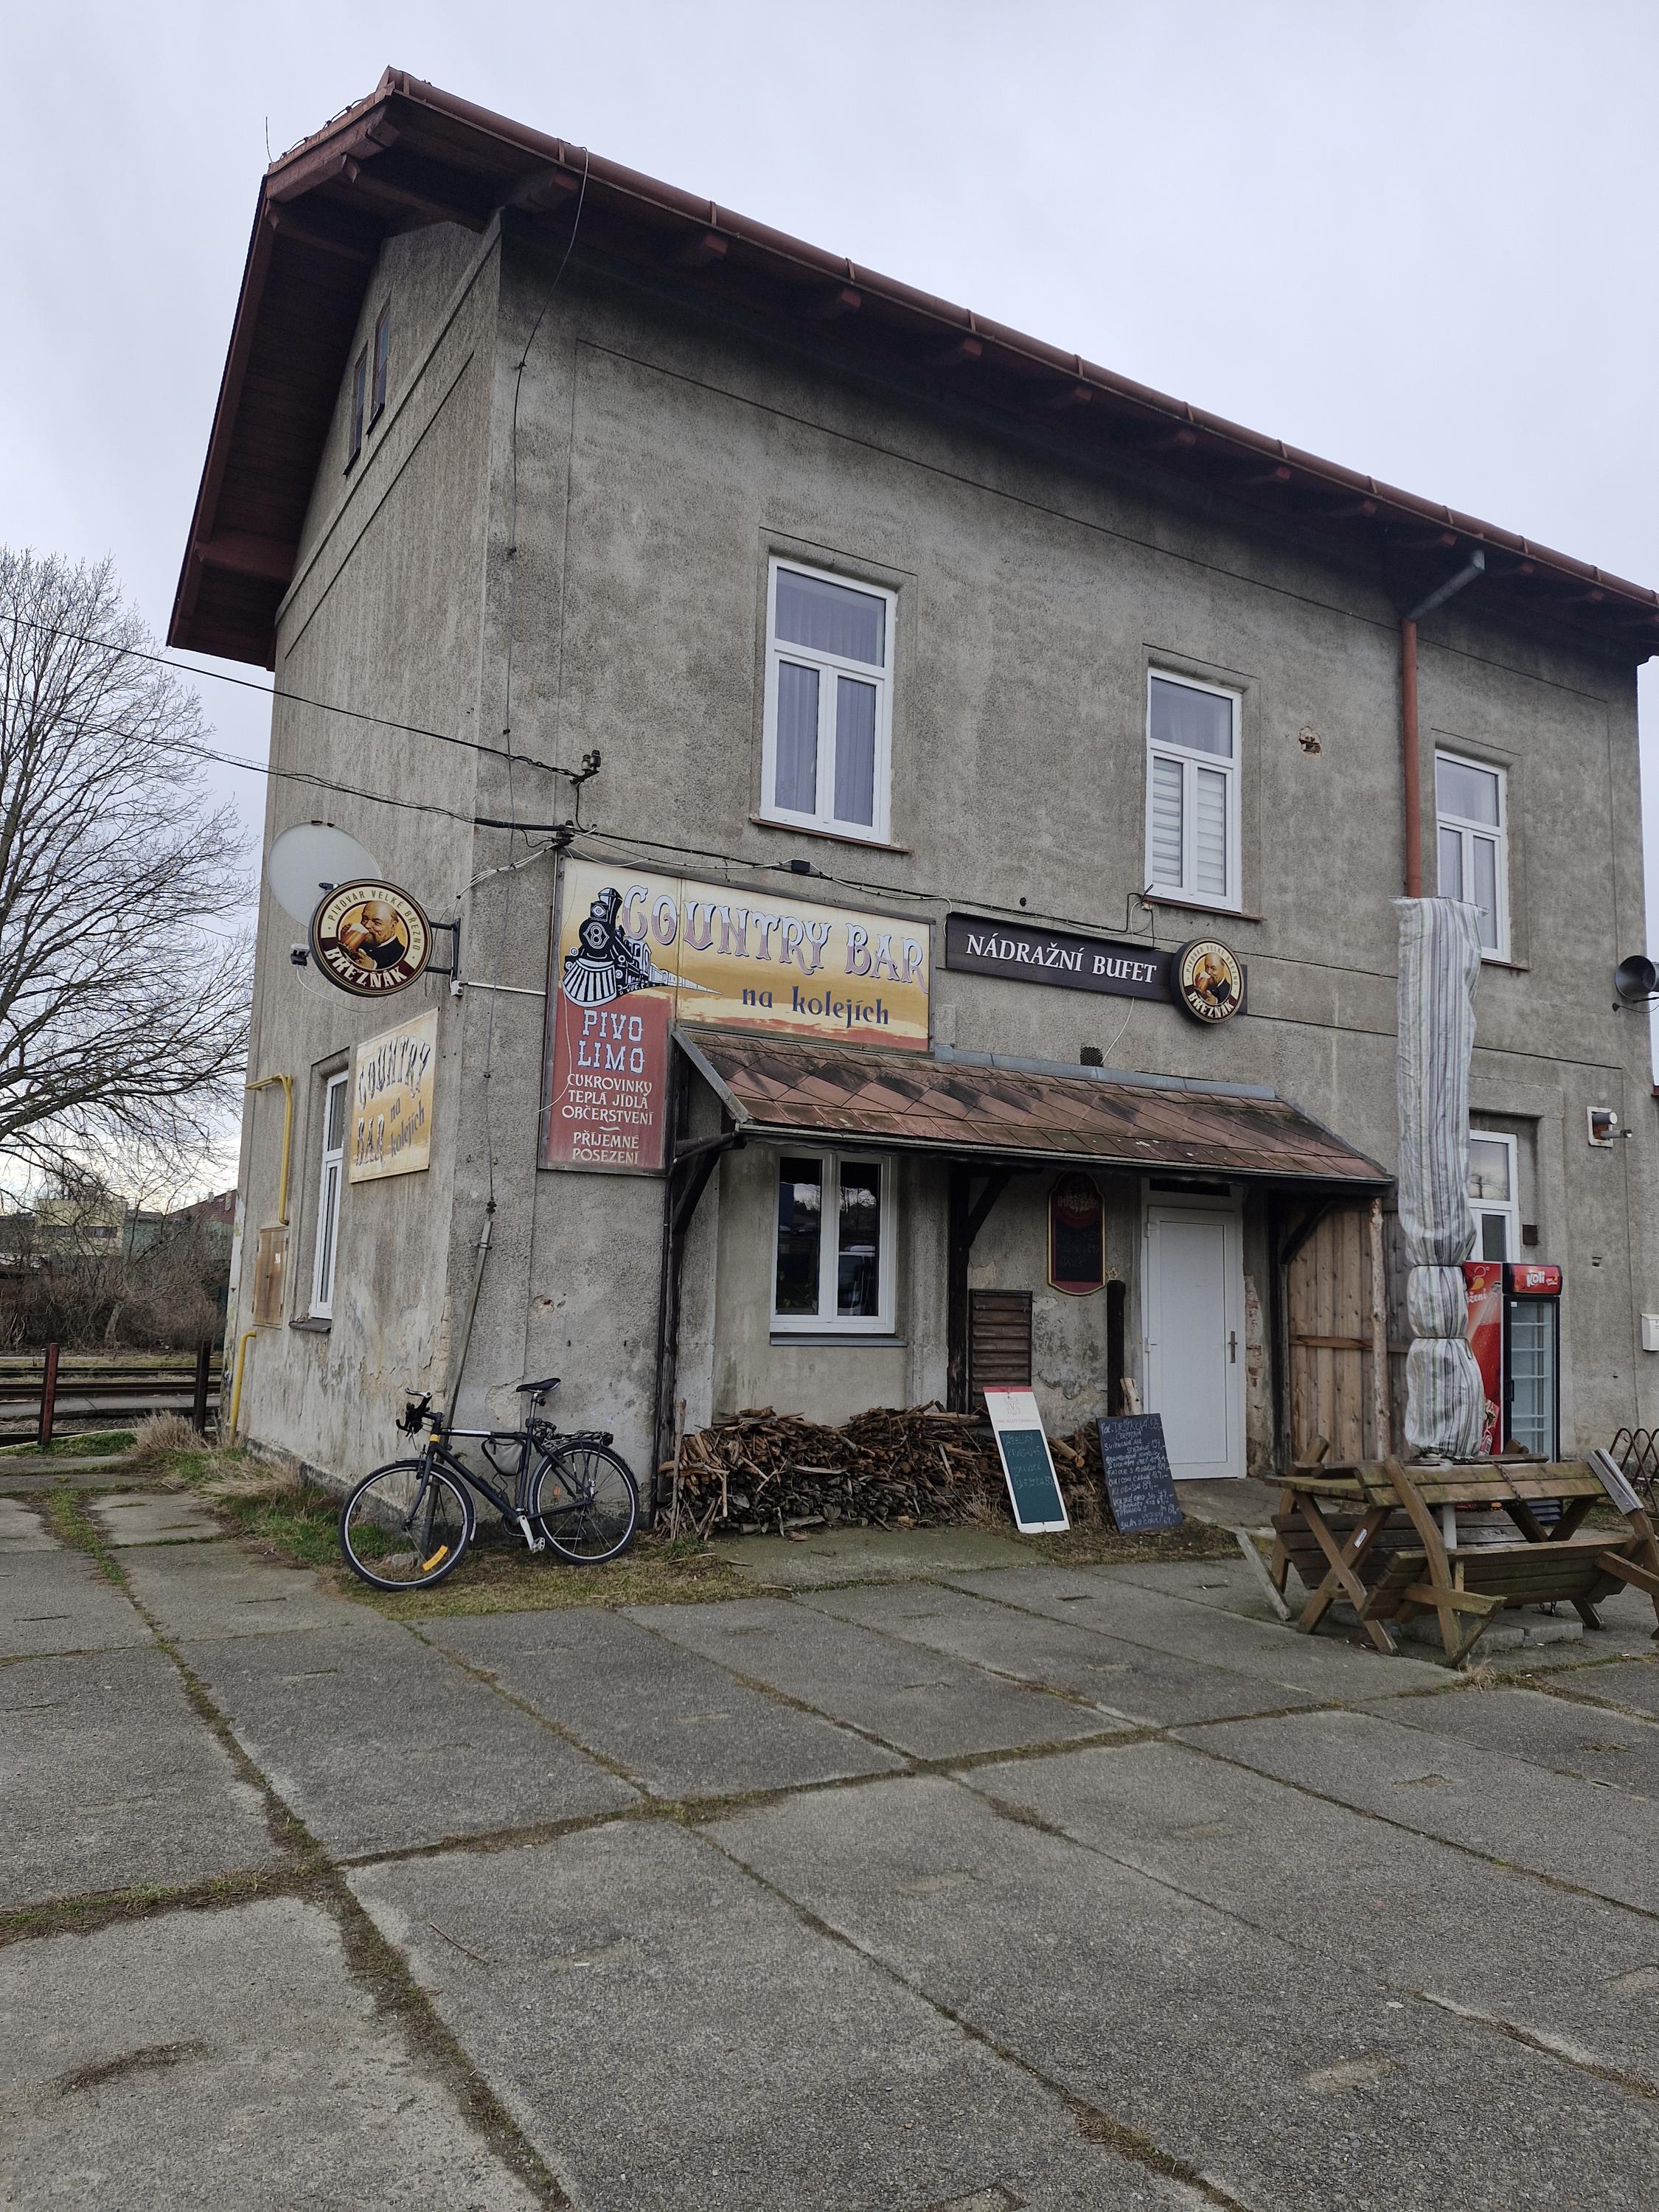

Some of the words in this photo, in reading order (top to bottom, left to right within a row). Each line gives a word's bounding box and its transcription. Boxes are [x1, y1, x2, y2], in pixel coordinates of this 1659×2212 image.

[328, 891, 366, 921] PIVOVAR
[372, 890, 403, 908] VELKÉ
[404, 910, 422, 950] BŘEZNO
[622, 885, 832, 976] COUNTRY
[845, 922, 929, 994] BAR
[324, 946, 408, 988] BŘEZŇÁK
[966, 932, 1085, 972] NÁDRAŽNÍ
[1092, 955, 1157, 984] BUFET
[1186, 947, 1204, 973] PIVOVAR
[742, 987, 773, 1009] na
[793, 985, 889, 1029] kolejích
[582, 1009, 644, 1042] PIVO
[358, 1034, 431, 1110] COUNTRY
[577, 1040, 645, 1074] LIMO
[567, 1074, 652, 1097] CUKROVINKY
[568, 1089, 607, 1106] TEPLÁ
[613, 1091, 648, 1109] JÍDLA
[390, 1097, 401, 1123] na
[562, 1104, 655, 1125] OBČERSTVENÍ
[356, 1113, 385, 1167] BAR
[390, 1099, 425, 1158] kolejích
[573, 1130, 639, 1150] PŘÍJEMNÉ
[572, 1147, 639, 1164] POSEZENÍ
